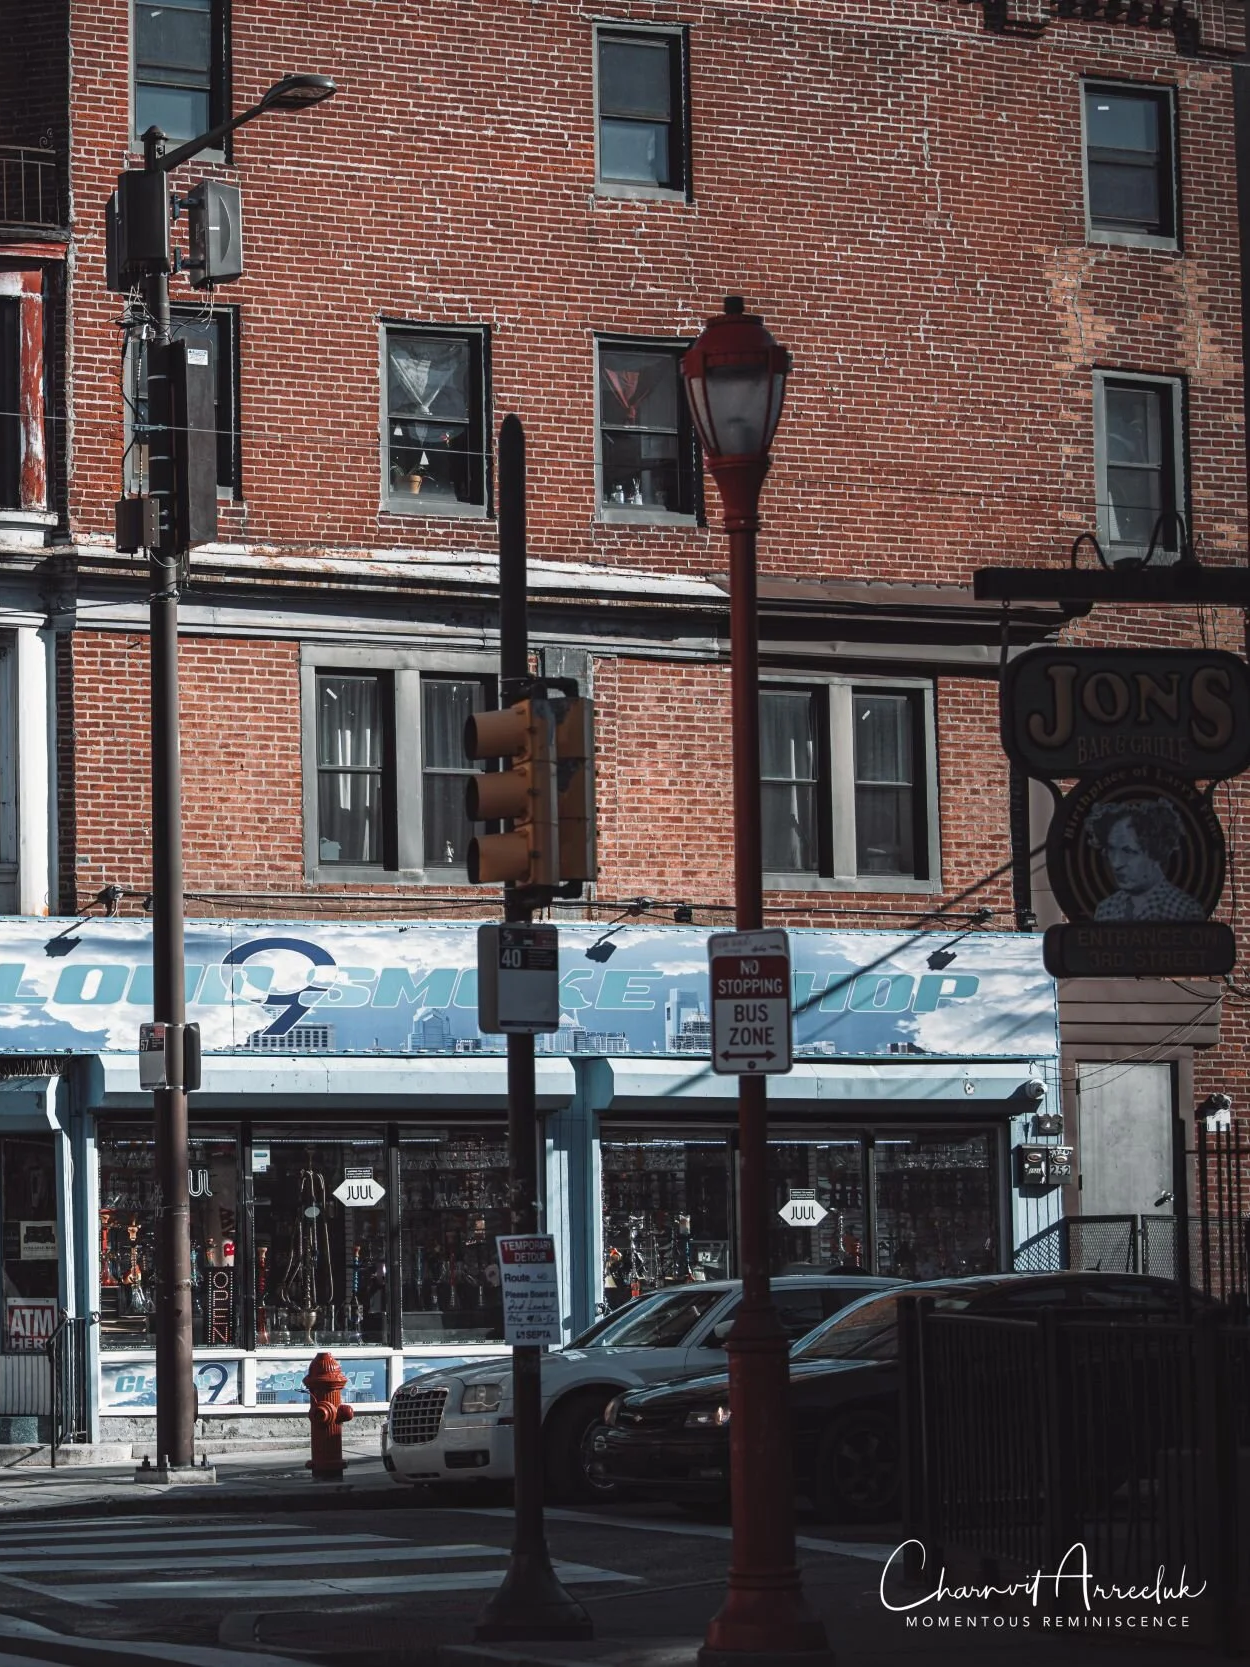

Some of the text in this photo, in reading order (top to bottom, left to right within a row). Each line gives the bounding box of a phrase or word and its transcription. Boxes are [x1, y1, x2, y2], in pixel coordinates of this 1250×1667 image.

[1027, 665, 1234, 749] JONS
[1077, 735, 1189, 765] BAR & GRILLE
[1064, 770, 1127, 840] Birthplace
[1132, 765, 1148, 778] of
[1155, 768, 1199, 800] Larry
[1077, 927, 1221, 947] ENTRANCE ON
[501, 948, 522, 968] 40
[1089, 949, 1207, 968] 3RD STREET
[740, 959, 760, 975] NO
[219, 937, 339, 1038] 9
[791, 970, 981, 1014] HOP
[718, 978, 783, 994] STOPPING
[734, 1004, 769, 1022] BUS
[140, 1039, 149, 1051] 57
[729, 1027, 775, 1046] ZONE
[1051, 1165, 1070, 1176] 252
[346, 1185, 374, 1201] JUUL
[790, 1205, 816, 1220] JUUL
[502, 1240, 552, 1251] TEMPORARY
[514, 1252, 547, 1263] DETOUR
[504, 1273, 531, 1283] Route
[211, 1270, 231, 1344] OPEN
[10, 1308, 50, 1337] ATM
[11, 1337, 51, 1350] HER
[526, 1330, 551, 1340] SEPTA
